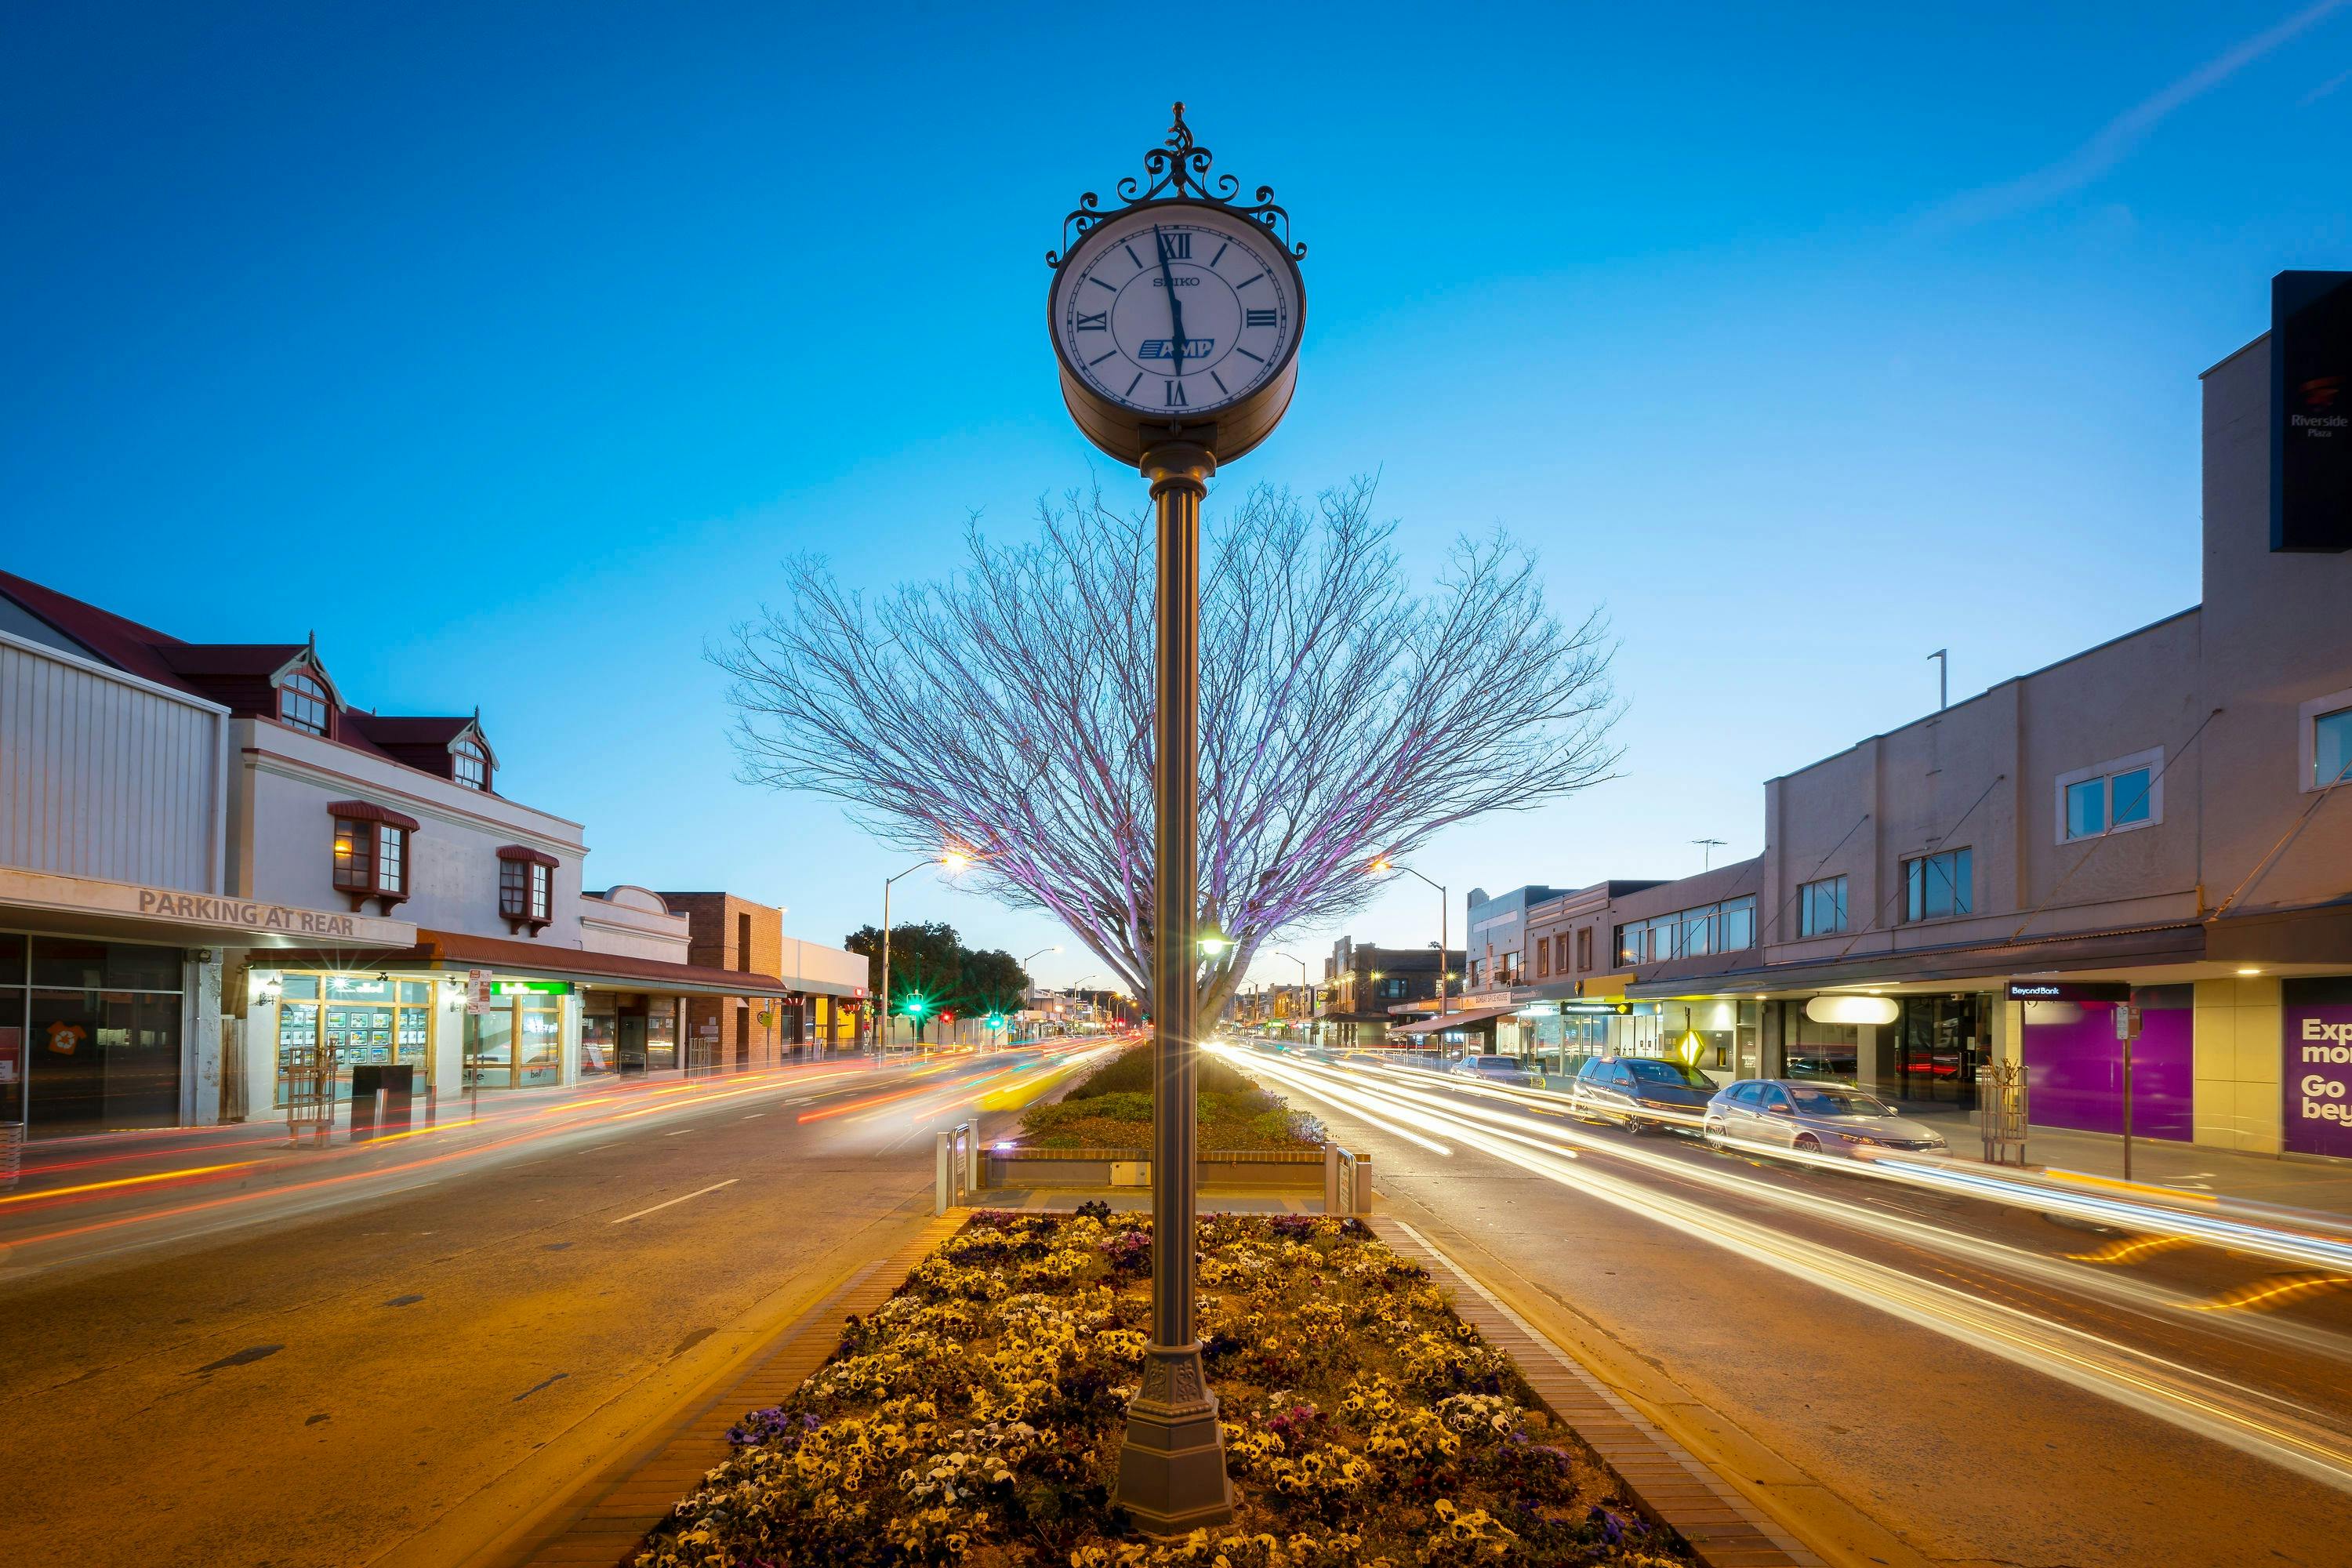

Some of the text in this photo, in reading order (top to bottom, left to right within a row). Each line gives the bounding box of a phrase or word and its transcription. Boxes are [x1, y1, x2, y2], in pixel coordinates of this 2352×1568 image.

[2292, 415, 2348, 426] Riverside
[139, 890, 354, 936] PARKING AT REAR
[2012, 986, 2040, 995] Beyond
[2302, 1018, 2352, 1046] Exp
[2302, 1046, 2352, 1064] mo
[2301, 1075, 2346, 1098] Go
[2302, 1097, 2352, 1127] bey
